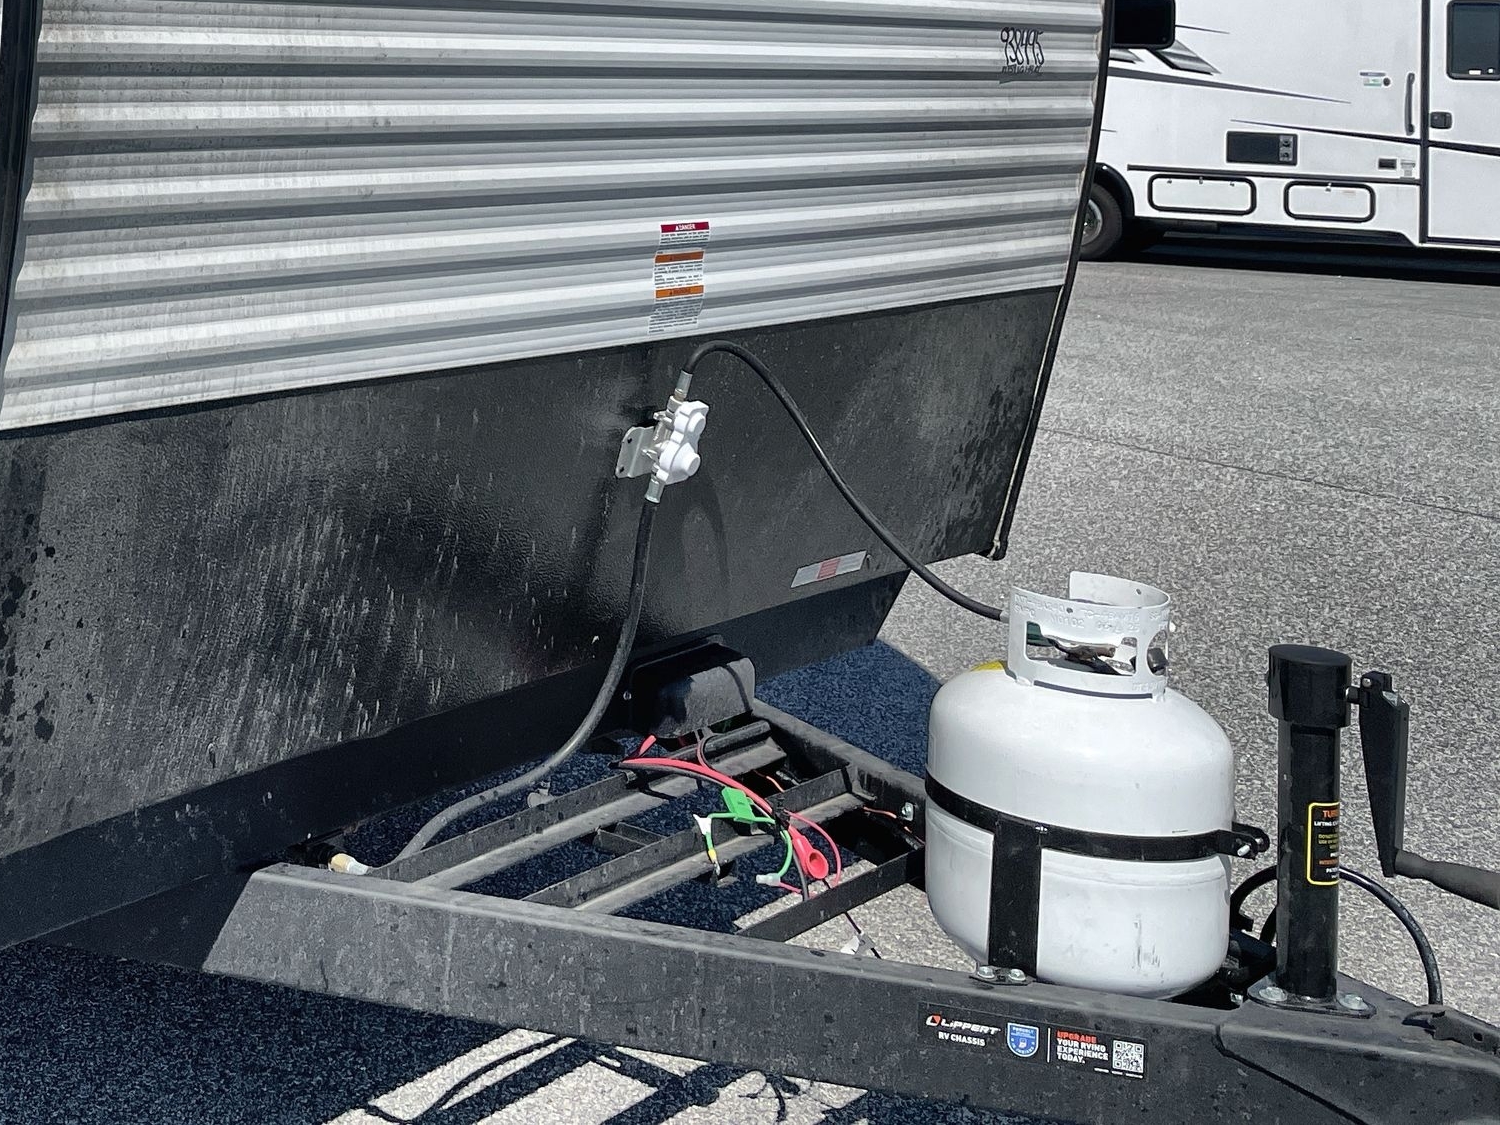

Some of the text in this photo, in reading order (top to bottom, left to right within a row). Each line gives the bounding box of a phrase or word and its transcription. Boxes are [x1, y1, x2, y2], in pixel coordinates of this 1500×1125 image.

[938, 1031, 986, 1047] RV CHASSIS
[1057, 1030, 1097, 1044] UPGRADE
[1057, 1038, 1080, 1050] YOUR
[1057, 1045, 1109, 1061] EXPERIENCE
[1057, 1053, 1086, 1064] TODAY.
